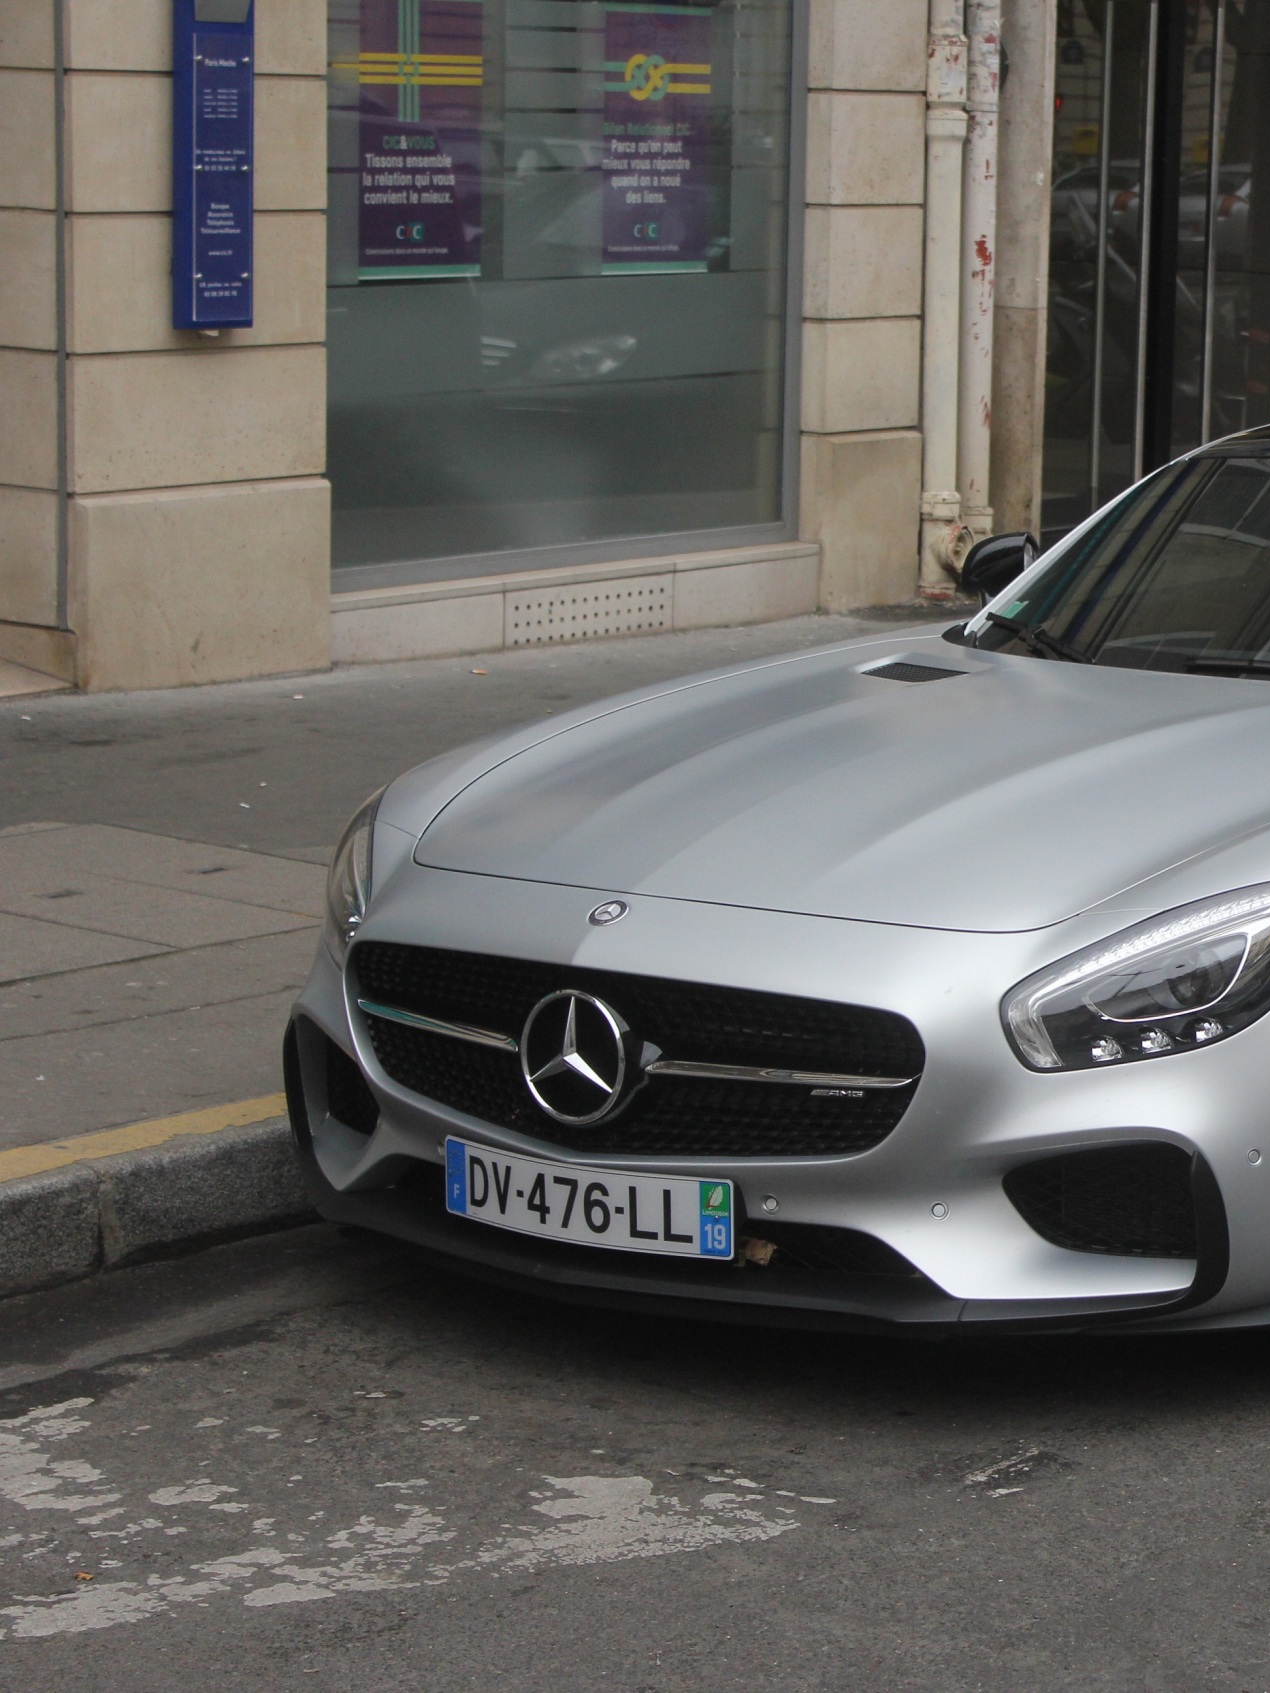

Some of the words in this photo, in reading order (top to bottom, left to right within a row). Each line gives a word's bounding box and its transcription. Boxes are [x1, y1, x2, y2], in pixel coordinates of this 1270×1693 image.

[383, 136, 436, 150] CIC&VOUS
[611, 140, 636, 152] Parce
[638, 140, 661, 155] qu'on
[663, 142, 682, 155] peut
[365, 154, 404, 168] Tissons
[406, 154, 452, 168] ensemble
[602, 156, 628, 170] mieux
[630, 159, 650, 170] vous
[652, 156, 690, 172] répondre
[362, 172, 373, 186] la
[374, 172, 412, 186] relation
[414, 172, 430, 188] qui
[432, 174, 455, 186] vous
[611, 174, 638, 190] quand
[640, 176, 651, 186] on
[652, 176, 659, 186] a
[660, 174, 681, 186] noué
[364, 190, 408, 204] convient
[409, 190, 418, 204] le
[420, 190, 454, 204] mieux.
[626, 190, 642, 204] des
[643, 190, 667, 204] liens.
[396, 225, 422, 240] CIC
[634, 224, 657, 238] CIC
[828, 1089, 864, 1098] AMG
[453, 1184, 460, 1199] F
[469, 1154, 694, 1244] DV-476-LL
[704, 1223, 726, 1250] 19
